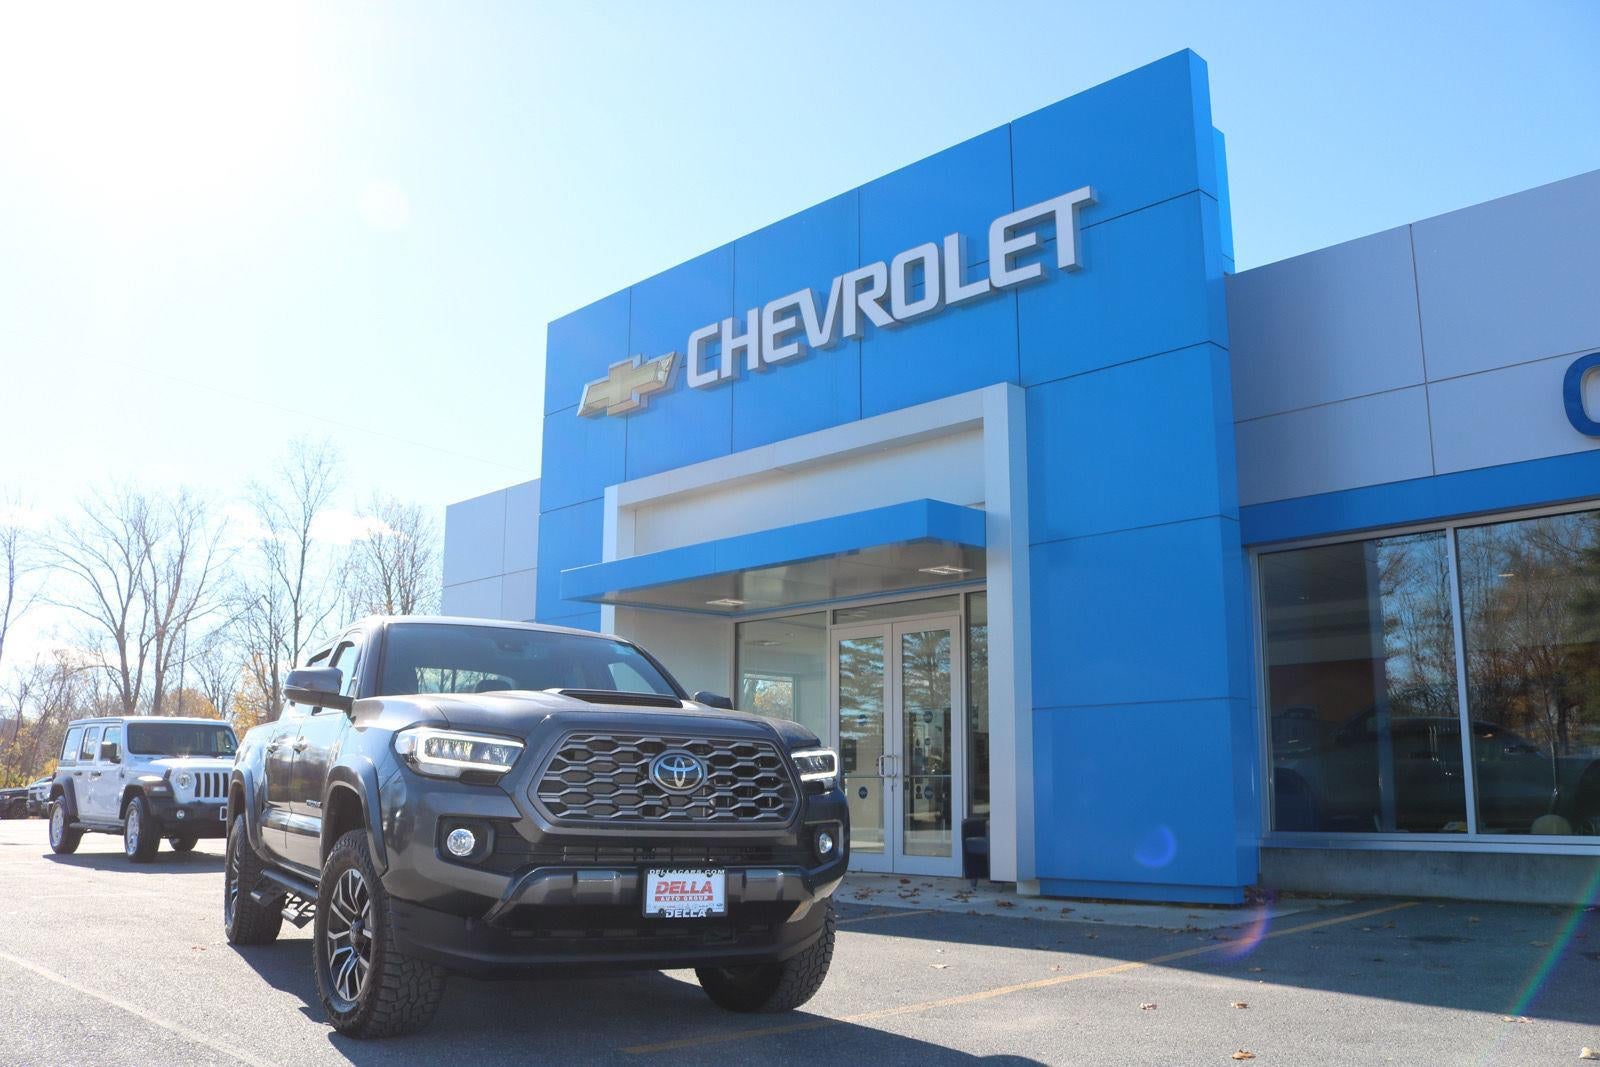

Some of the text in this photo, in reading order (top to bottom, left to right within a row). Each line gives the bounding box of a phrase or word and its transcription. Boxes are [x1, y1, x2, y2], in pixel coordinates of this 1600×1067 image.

[687, 185, 1096, 389] CHEVROLET
[655, 881, 713, 894] DELLA
[665, 909, 706, 918] DELLA
